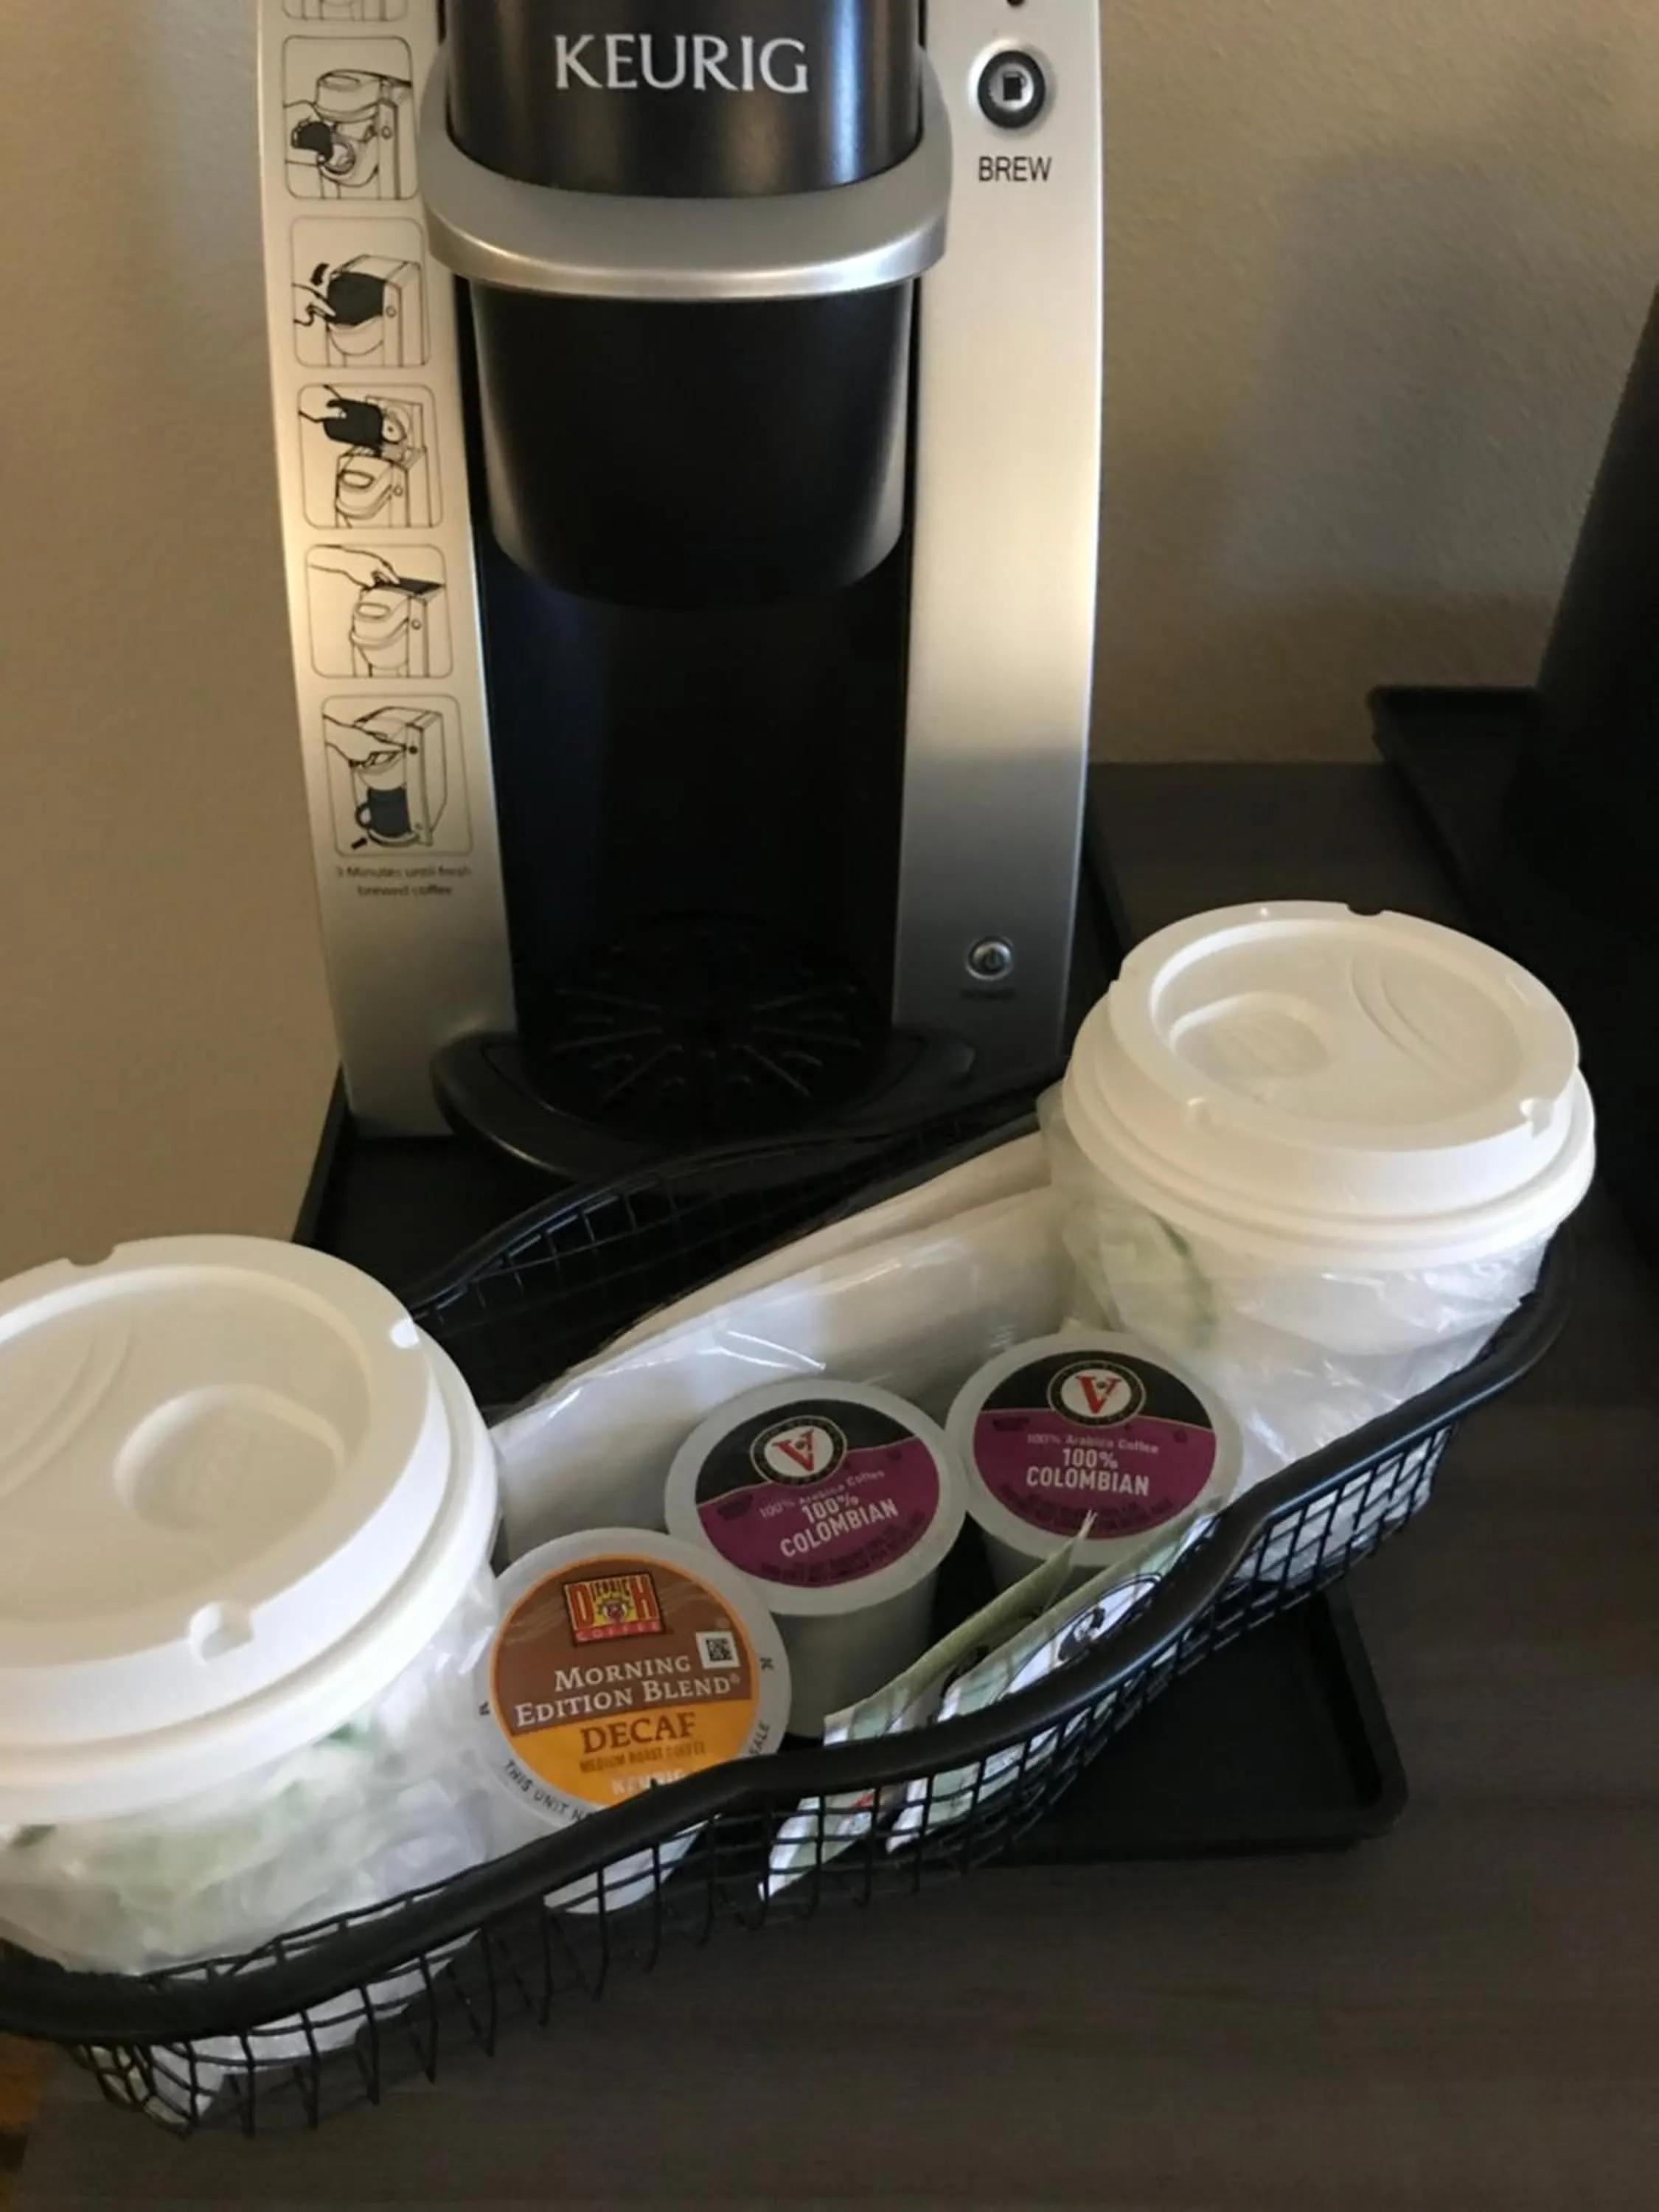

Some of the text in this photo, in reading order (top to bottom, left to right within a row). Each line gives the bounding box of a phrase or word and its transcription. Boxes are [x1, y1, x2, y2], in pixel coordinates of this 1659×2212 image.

[554, 35, 810, 94] KEURIG
[978, 156, 1051, 182] BREW
[1062, 1447, 1119, 1470] 100%
[1117, 1439, 1160, 1455] Coffee
[1026, 1465, 1150, 1497] COLOMBIAN
[801, 1492, 860, 1524] 100%
[779, 1498, 899, 1559] COLOMBIAN
[554, 1655, 692, 1692] MORNING
[515, 1686, 634, 1727] EDITION
[580, 1711, 697, 1754] DECAF
[504, 1759, 534, 1792] THIS
[533, 1789, 570, 1815] UNIT
